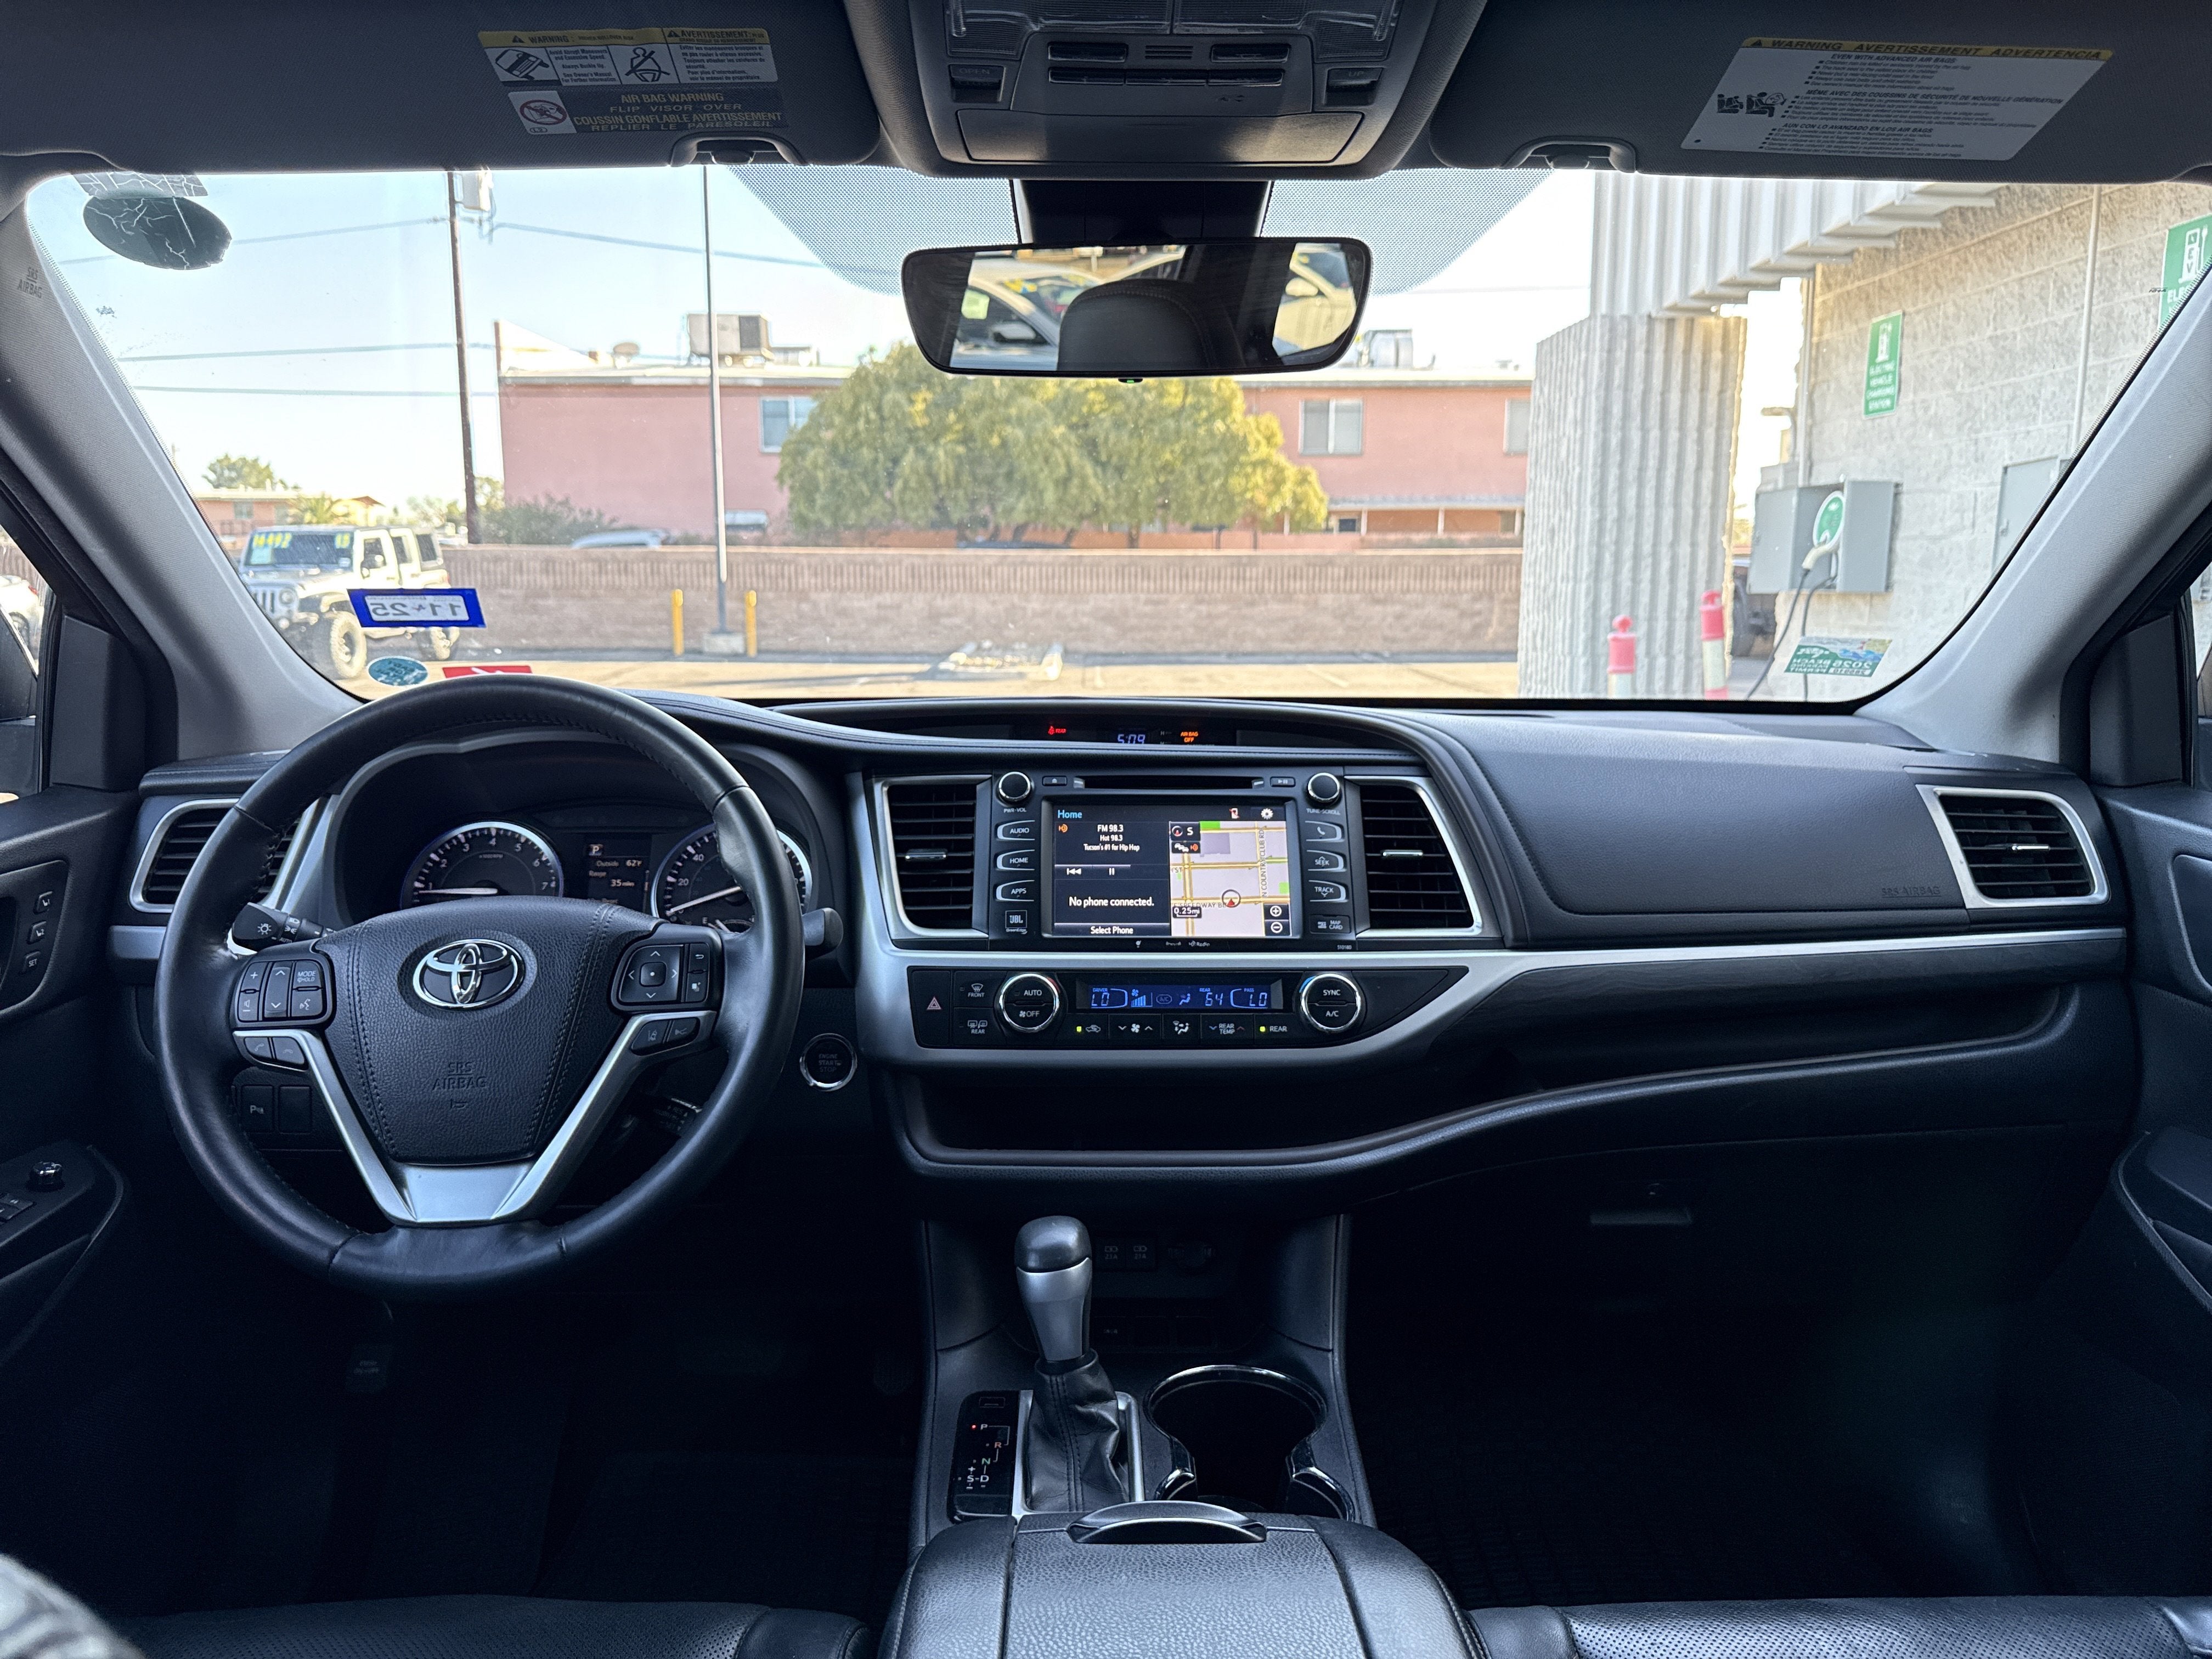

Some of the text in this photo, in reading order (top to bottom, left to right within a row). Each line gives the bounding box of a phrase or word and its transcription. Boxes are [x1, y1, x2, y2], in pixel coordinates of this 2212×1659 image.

[1771, 40, 2102, 60] WARNING AVERTISSEMENT ADVERTENCIA
[621, 92, 724, 104] AIR BAG WARNING
[573, 111, 782, 126] COUSSIN GONFLABLE AVERTISSEMENT
[591, 120, 774, 132] REPLIER LE PARESOLEIL
[27, 267, 38, 281] SRS
[17, 279, 43, 299] AIRBAG
[1118, 733, 1146, 744] 5:09
[1058, 809, 1083, 819] Home
[1097, 824, 1124, 832] FM 98.3
[1187, 827, 1194, 836] S
[1259, 830, 1265, 838] RD
[489, 837, 496, 847] 4
[464, 843, 470, 852] 3
[515, 843, 522, 852] 5
[592, 845, 600, 855] P
[440, 859, 448, 868] 2
[533, 859, 540, 867] 6
[541, 882, 548, 890] 7
[1882, 886, 1940, 896] SRS AIRBAG
[1069, 896, 1155, 909] No phone connected.
[1009, 915, 1023, 924] JBL
[29, 959, 38, 968] SET
[1092, 992, 1110, 1007] LO
[1205, 992, 1224, 1007] 64
[1249, 992, 1268, 1007] LO
[448, 1062, 473, 1074] SRS
[432, 1076, 487, 1090] AIRBAG
